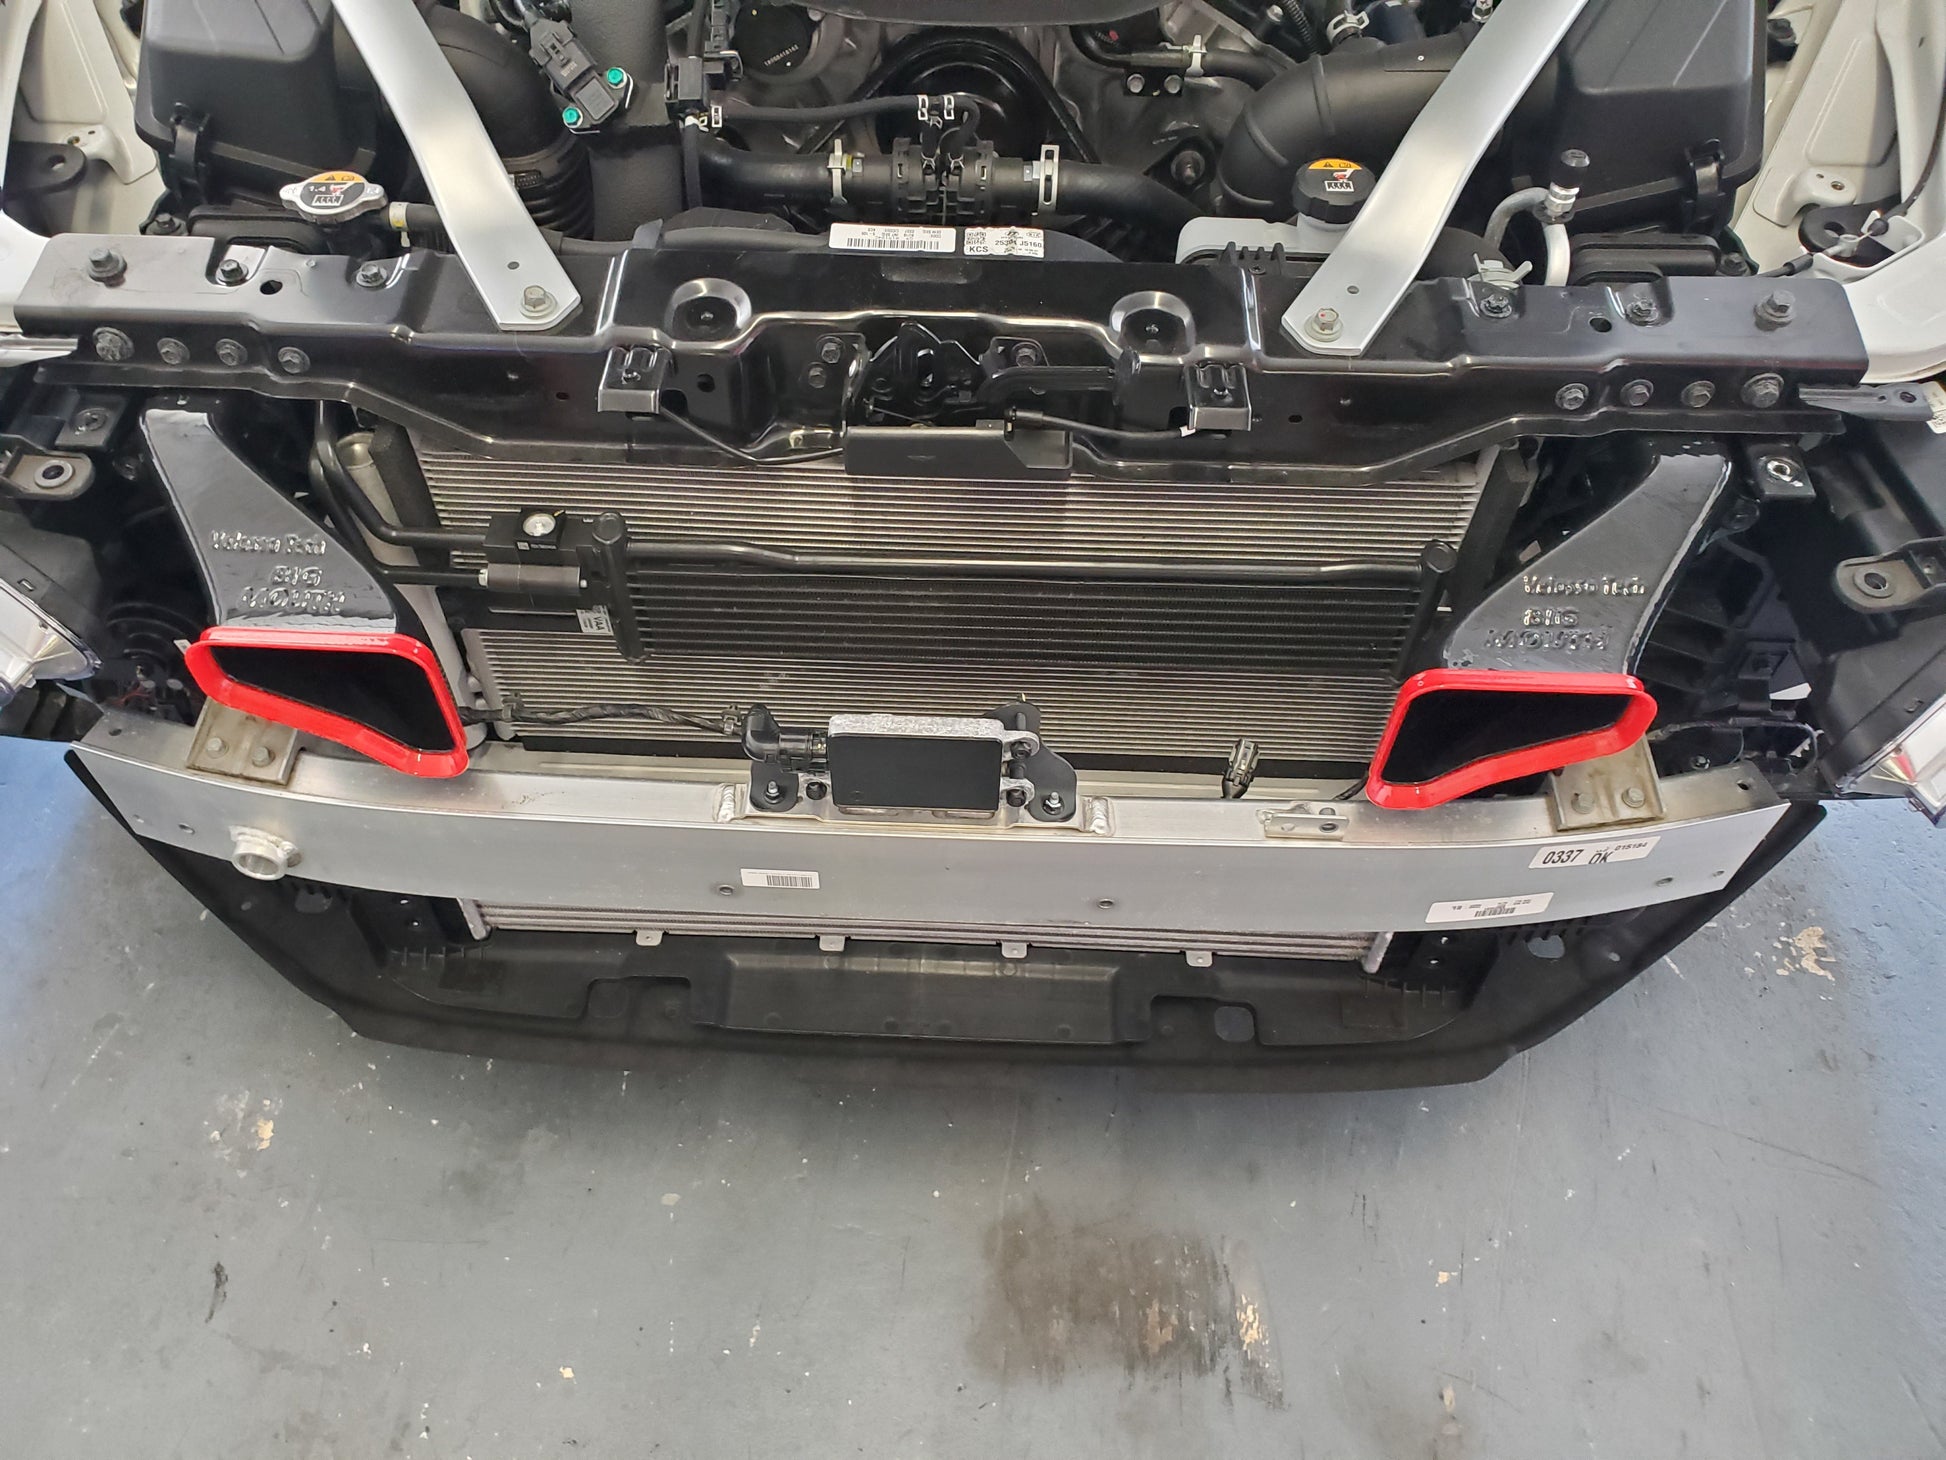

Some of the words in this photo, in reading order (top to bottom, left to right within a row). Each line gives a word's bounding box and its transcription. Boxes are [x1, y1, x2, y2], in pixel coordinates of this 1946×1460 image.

[969, 245, 989, 253] KCS
[272, 565, 322, 586] BIG
[1523, 606, 1580, 627] BIG
[1485, 626, 1613, 651] MOUTH
[1542, 849, 1584, 865] 0337
[1588, 851, 1614, 865] OK
